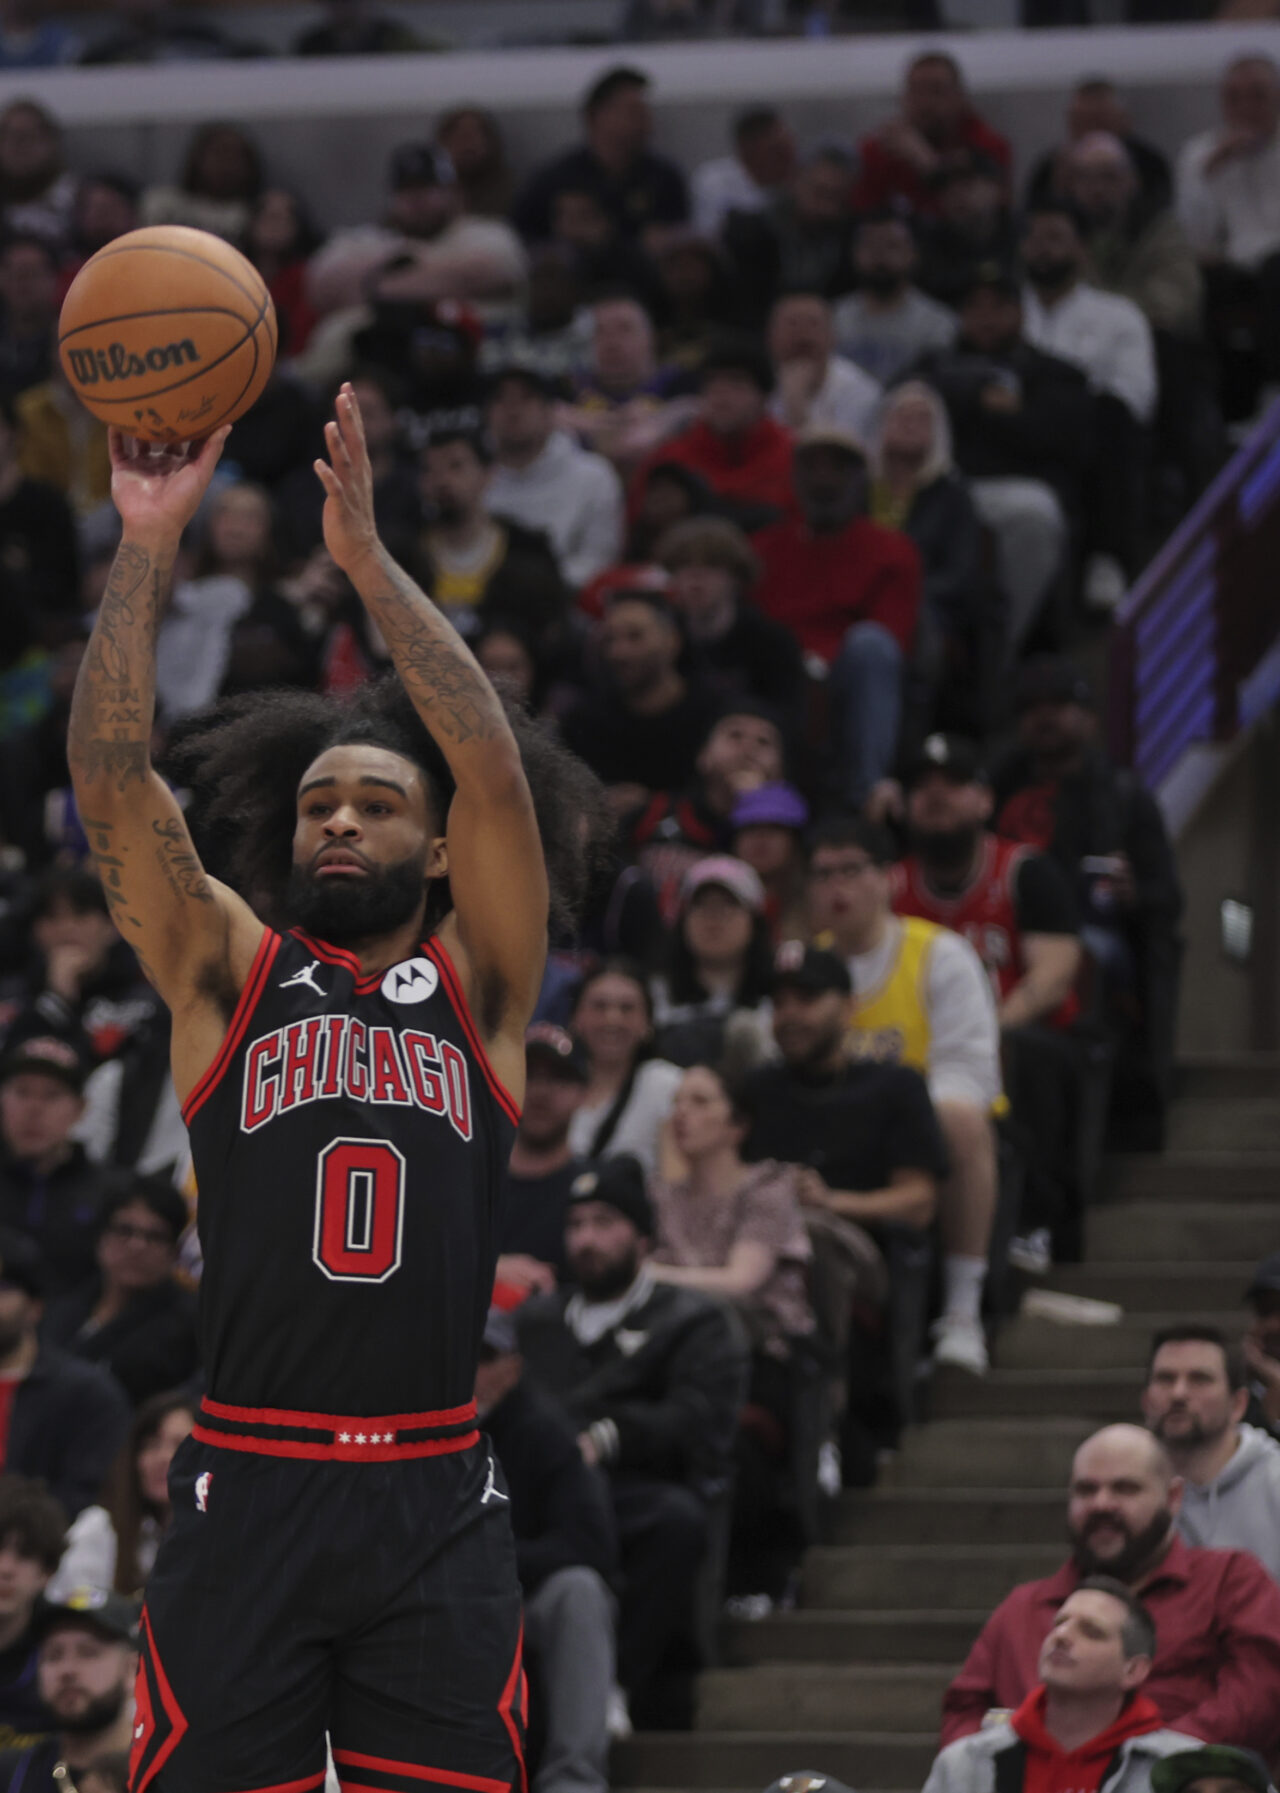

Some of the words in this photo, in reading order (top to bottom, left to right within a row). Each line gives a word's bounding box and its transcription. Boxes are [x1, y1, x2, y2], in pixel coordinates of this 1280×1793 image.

[67, 338, 201, 385] Wilson
[239, 1013, 474, 1143] CHICAGO
[312, 1135, 407, 1283] 0
